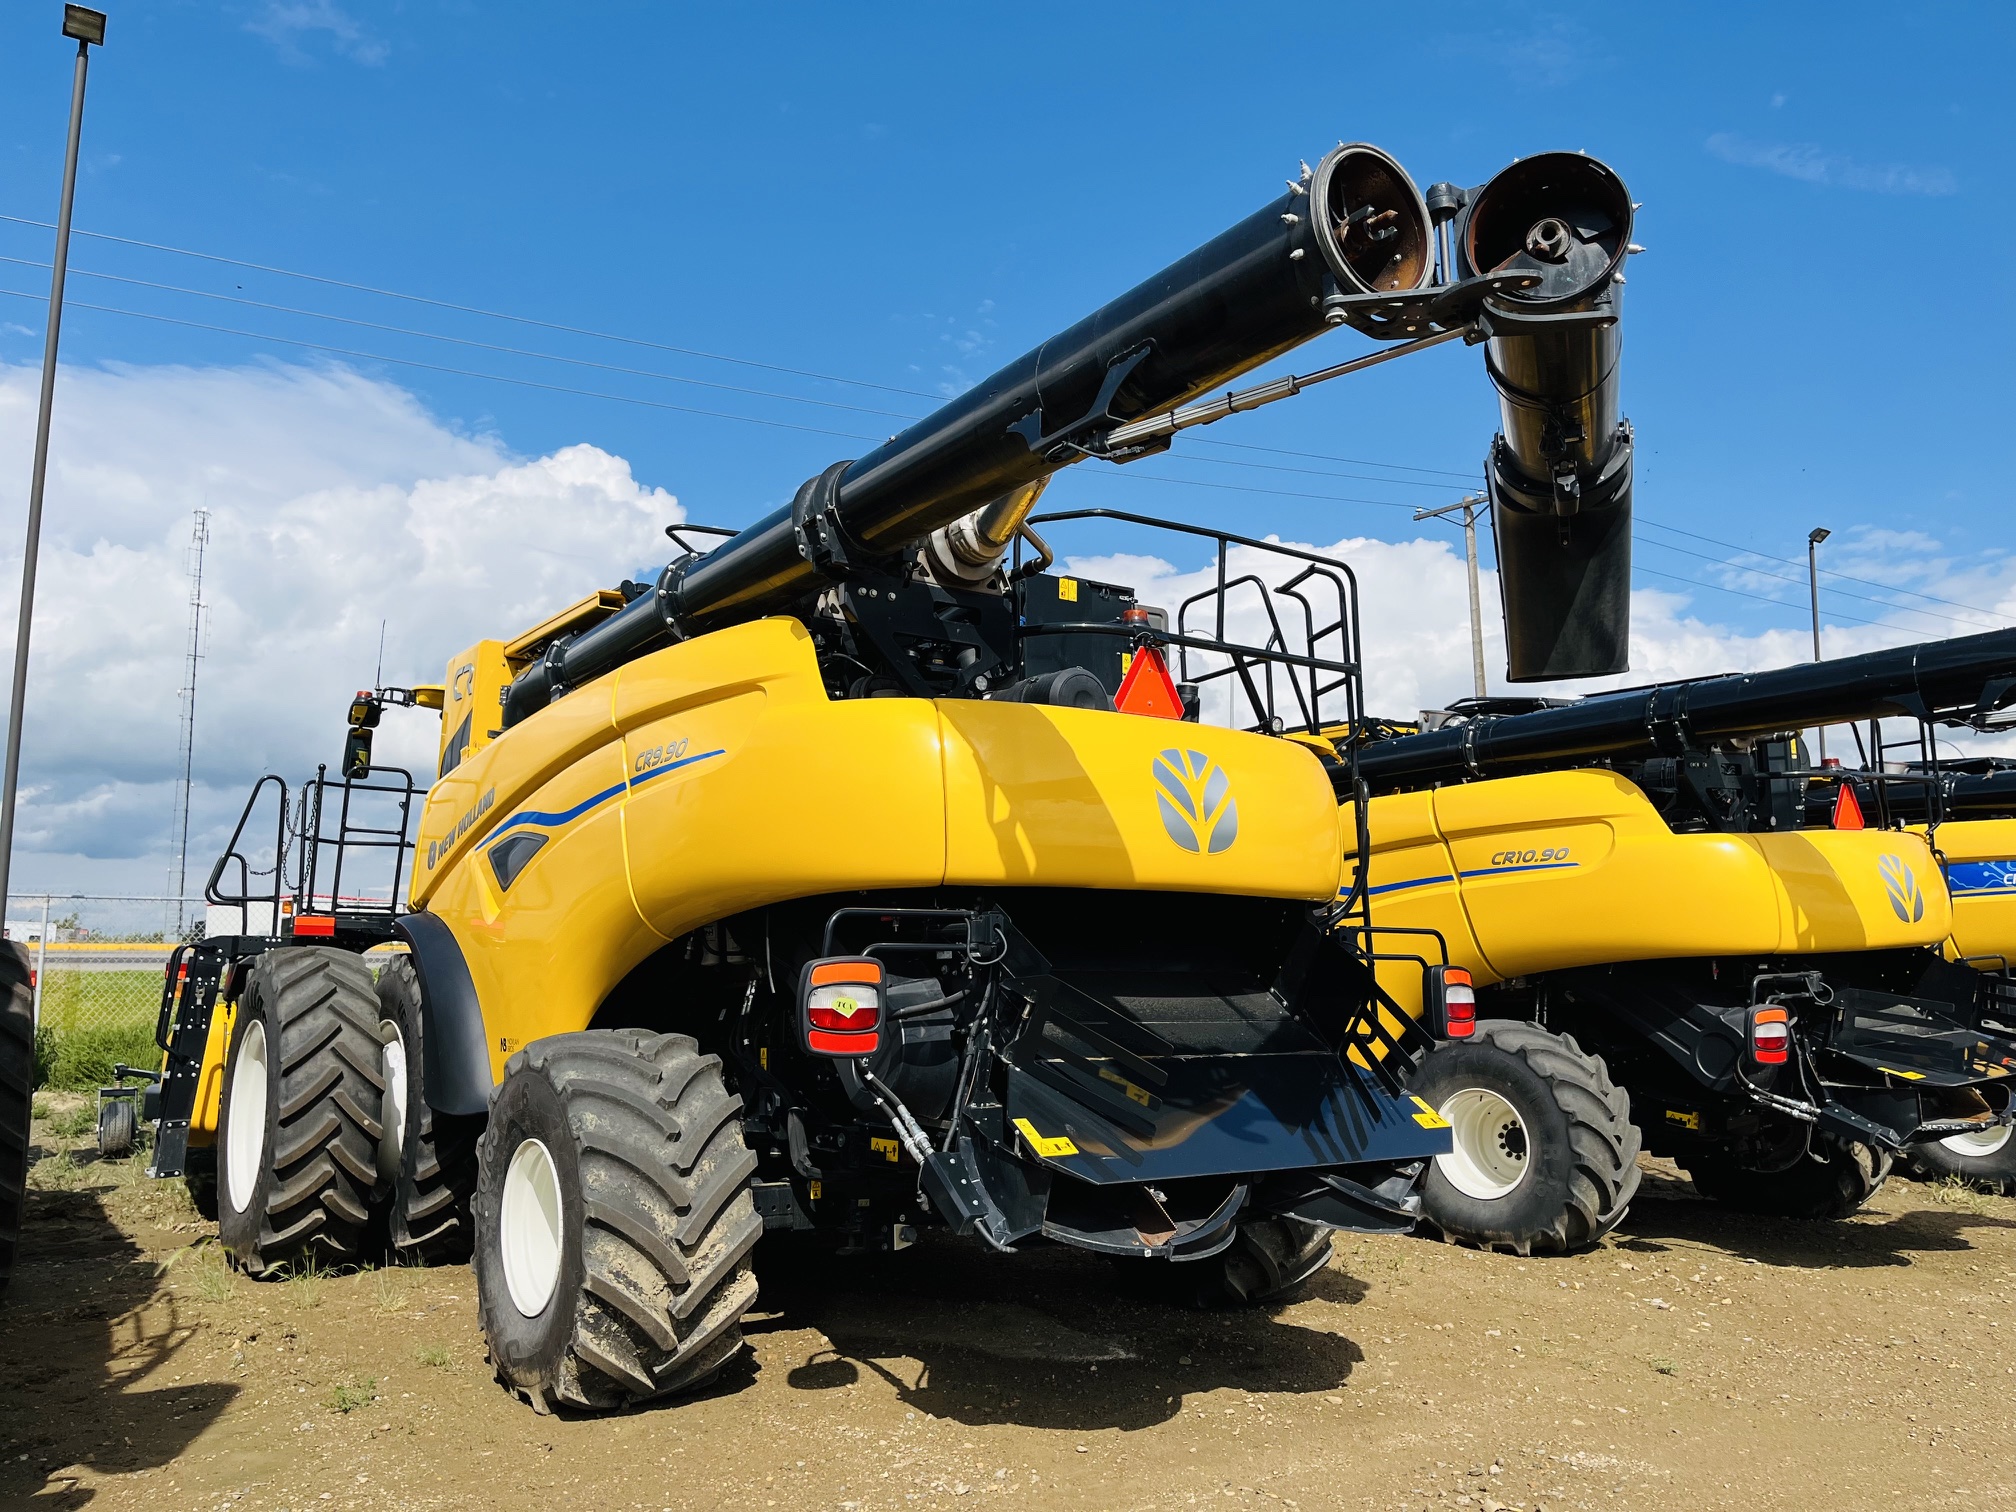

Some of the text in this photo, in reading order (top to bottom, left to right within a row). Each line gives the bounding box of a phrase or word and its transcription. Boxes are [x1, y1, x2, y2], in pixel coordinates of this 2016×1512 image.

[635, 738, 688, 772] CR9.90
[438, 787, 495, 861] NEW HOLLAND
[1491, 847, 1570, 865] CR10.90
